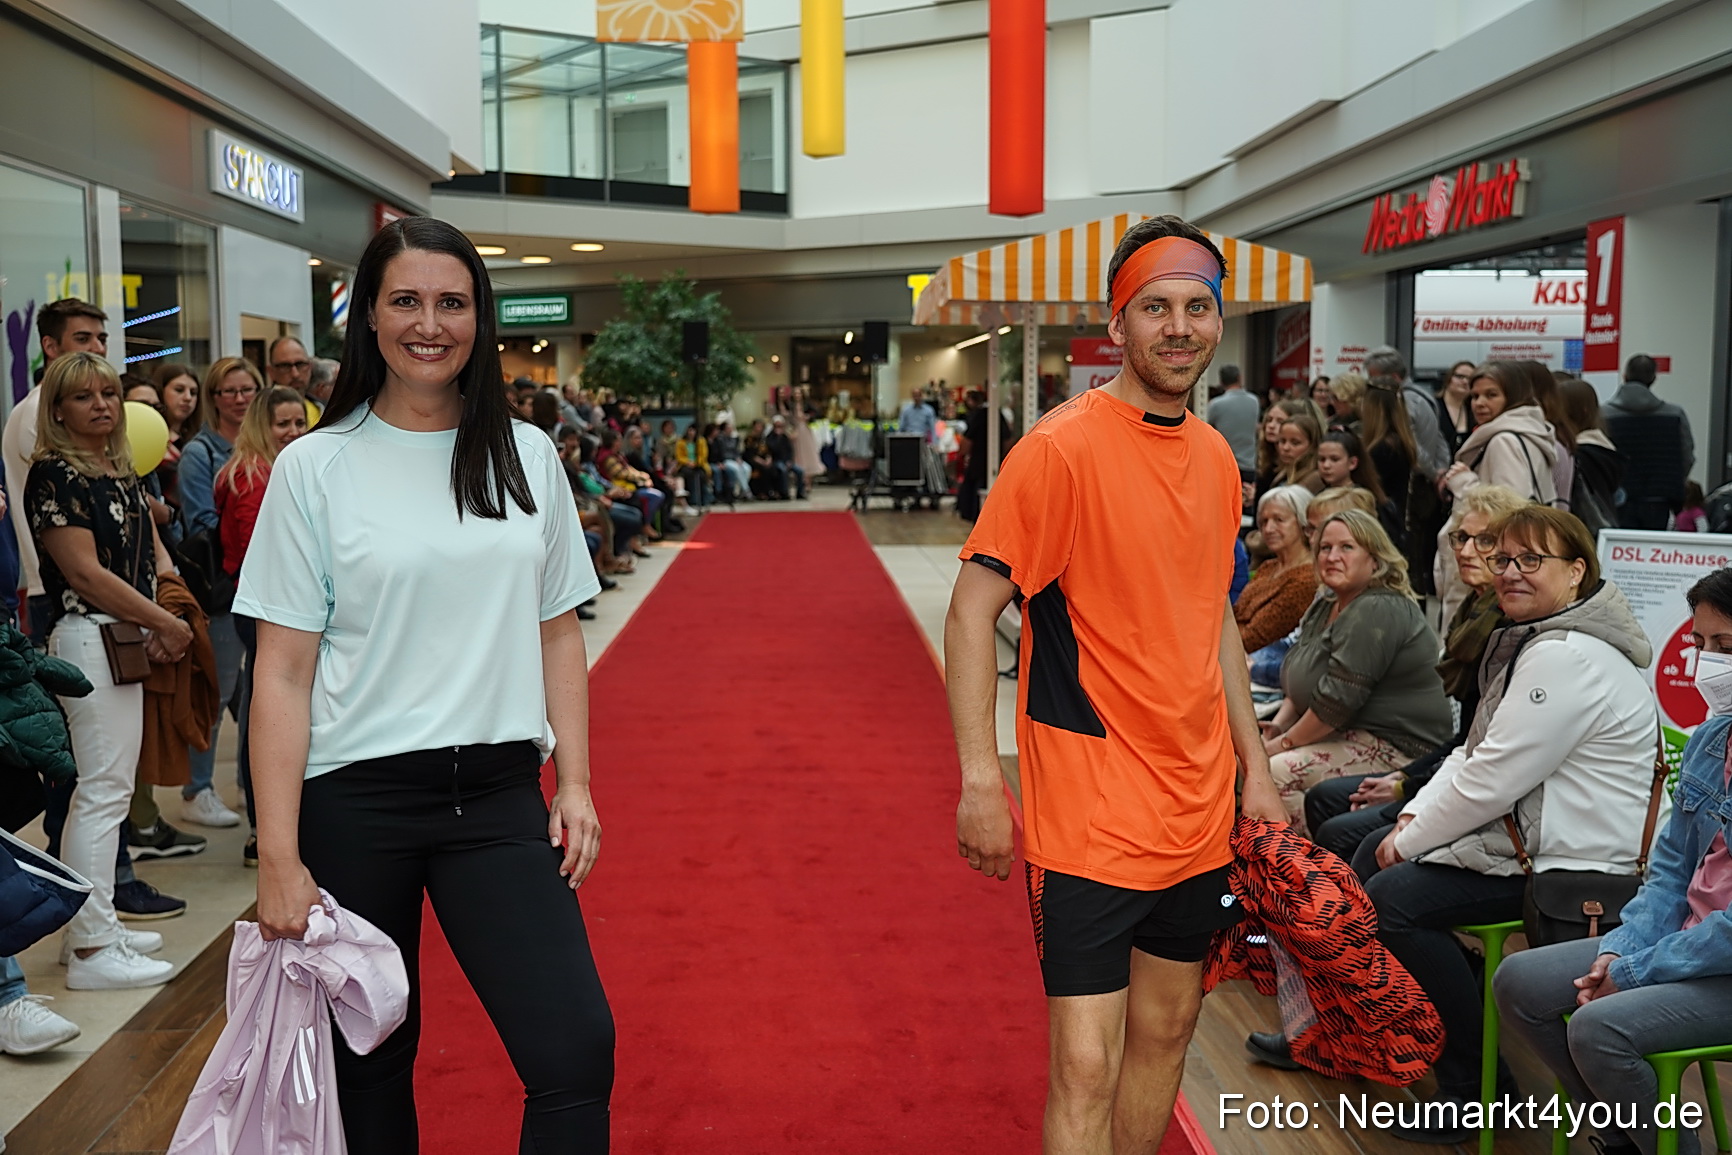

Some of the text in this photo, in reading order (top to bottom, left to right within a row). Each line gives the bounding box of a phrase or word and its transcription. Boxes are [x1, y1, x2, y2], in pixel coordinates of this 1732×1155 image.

[223, 144, 301, 214] STARCUT
[1362, 158, 1520, 254] Media Markt
[1596, 229, 1616, 307] 1
[1533, 279, 1587, 305] KAS
[506, 303, 565, 317] LEBENSRAUM
[1422, 317, 1549, 334] Online-Abholung
[1611, 546, 1729, 568] DSL Zuhause
[1663, 664, 1679, 676] ab
